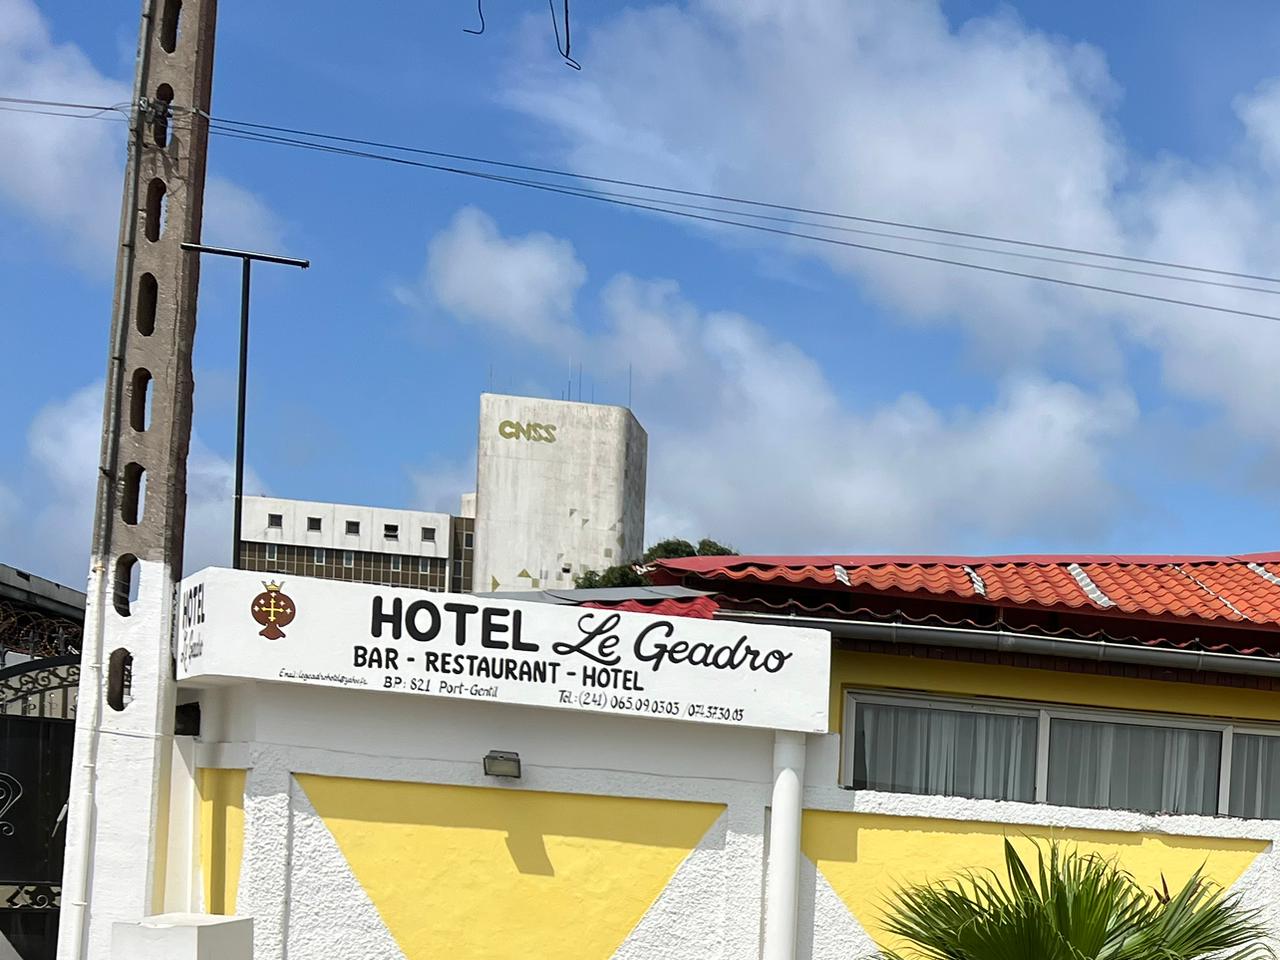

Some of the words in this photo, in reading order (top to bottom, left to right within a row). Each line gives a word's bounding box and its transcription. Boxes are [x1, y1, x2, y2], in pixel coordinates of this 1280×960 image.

[498, 419, 557, 443] CNSS
[182, 583, 205, 627] HOTEL
[371, 595, 540, 652] HOTEL
[551, 613, 621, 666] Le
[633, 620, 793, 674] Geadro
[353, 645, 399, 670] BAR
[424, 650, 561, 684] RESTAURANT
[582, 665, 645, 691] HOTEL
[438, 680, 499, 698] Port-Gentil
